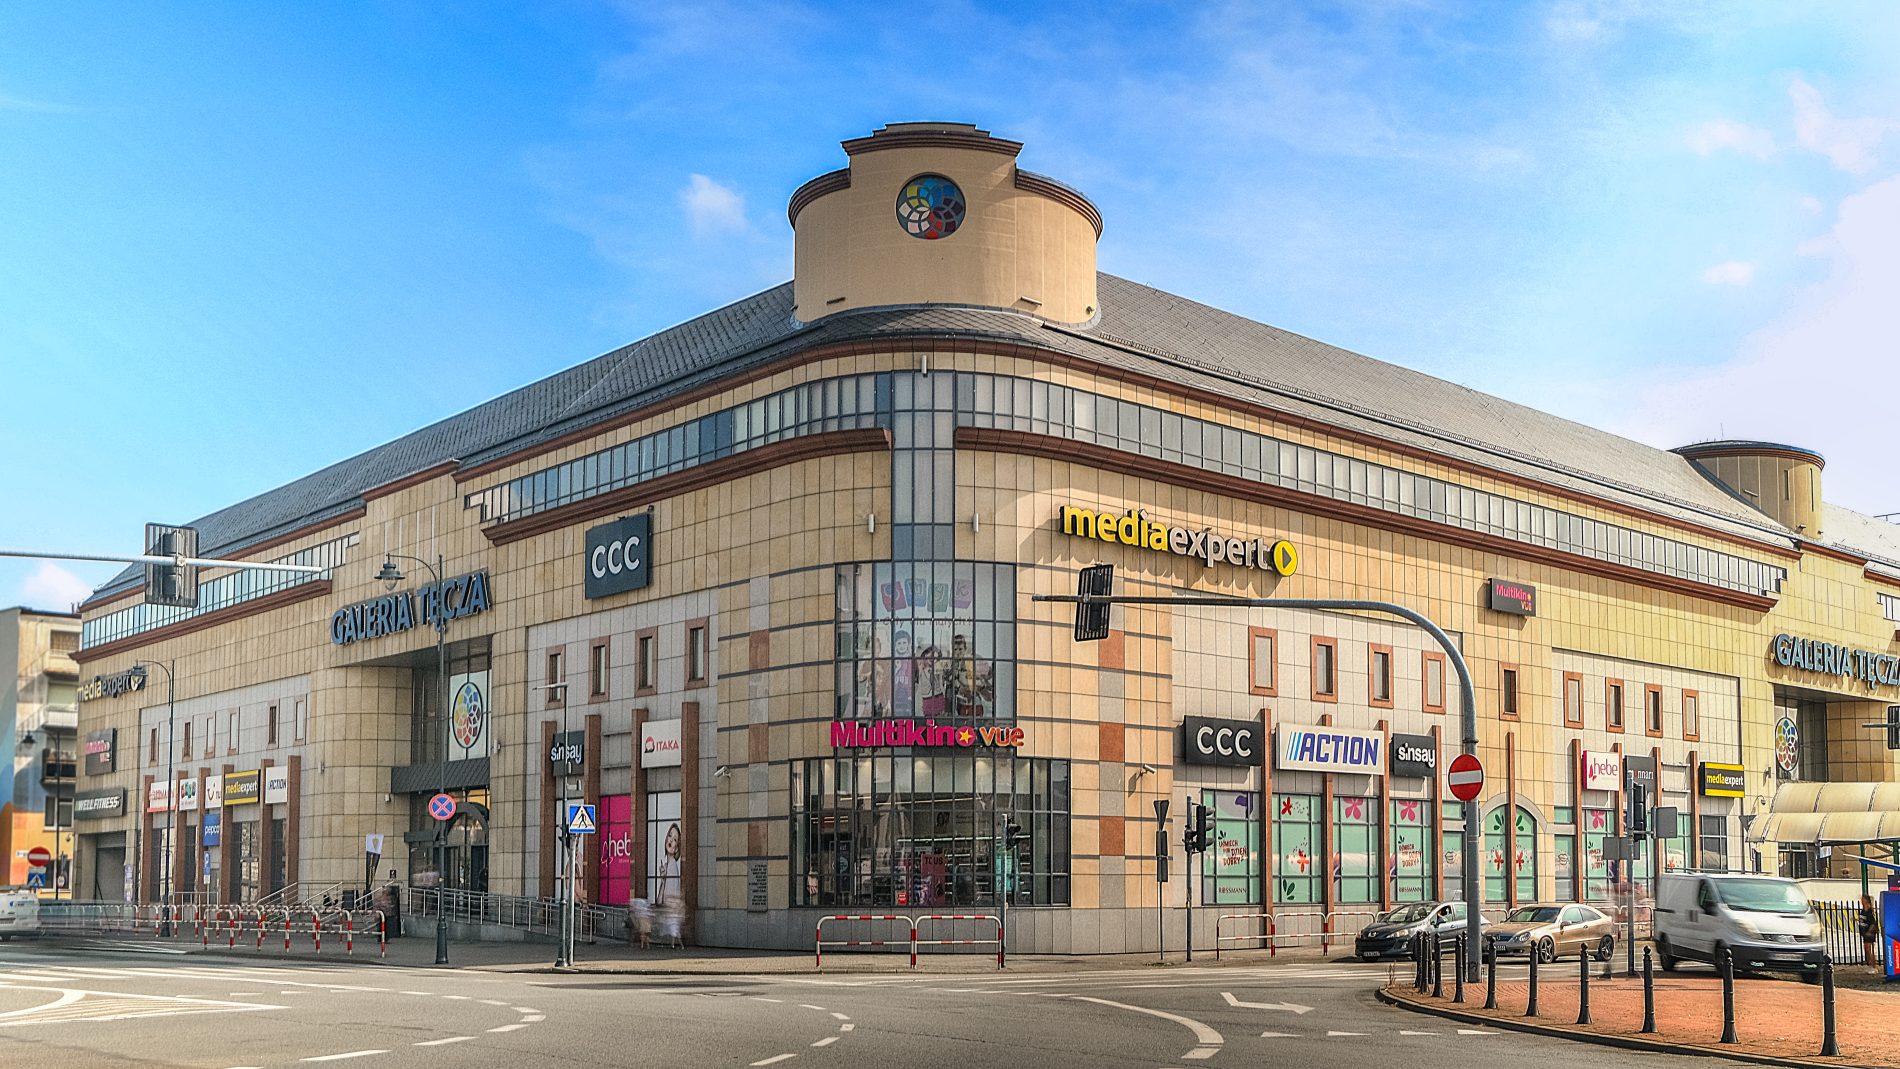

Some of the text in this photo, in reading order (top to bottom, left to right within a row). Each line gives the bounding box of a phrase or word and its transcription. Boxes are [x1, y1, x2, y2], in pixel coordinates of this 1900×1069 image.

[1061, 506, 1271, 570] mediaexpert
[591, 536, 640, 578] CCC
[331, 592, 415, 646] GALERIA
[1774, 633, 1900, 690] GALERIA TĘCZ
[656, 740, 679, 752] ITAKA
[831, 719, 1025, 748] Multikino vue
[1197, 726, 1252, 757] CCC
[1298, 732, 1380, 767] ACTION
[1398, 742, 1436, 768] sinsay
[1593, 757, 1618, 776] hebe
[1706, 773, 1743, 787] mediaexpert
[225, 780, 257, 795] mediaexpert
